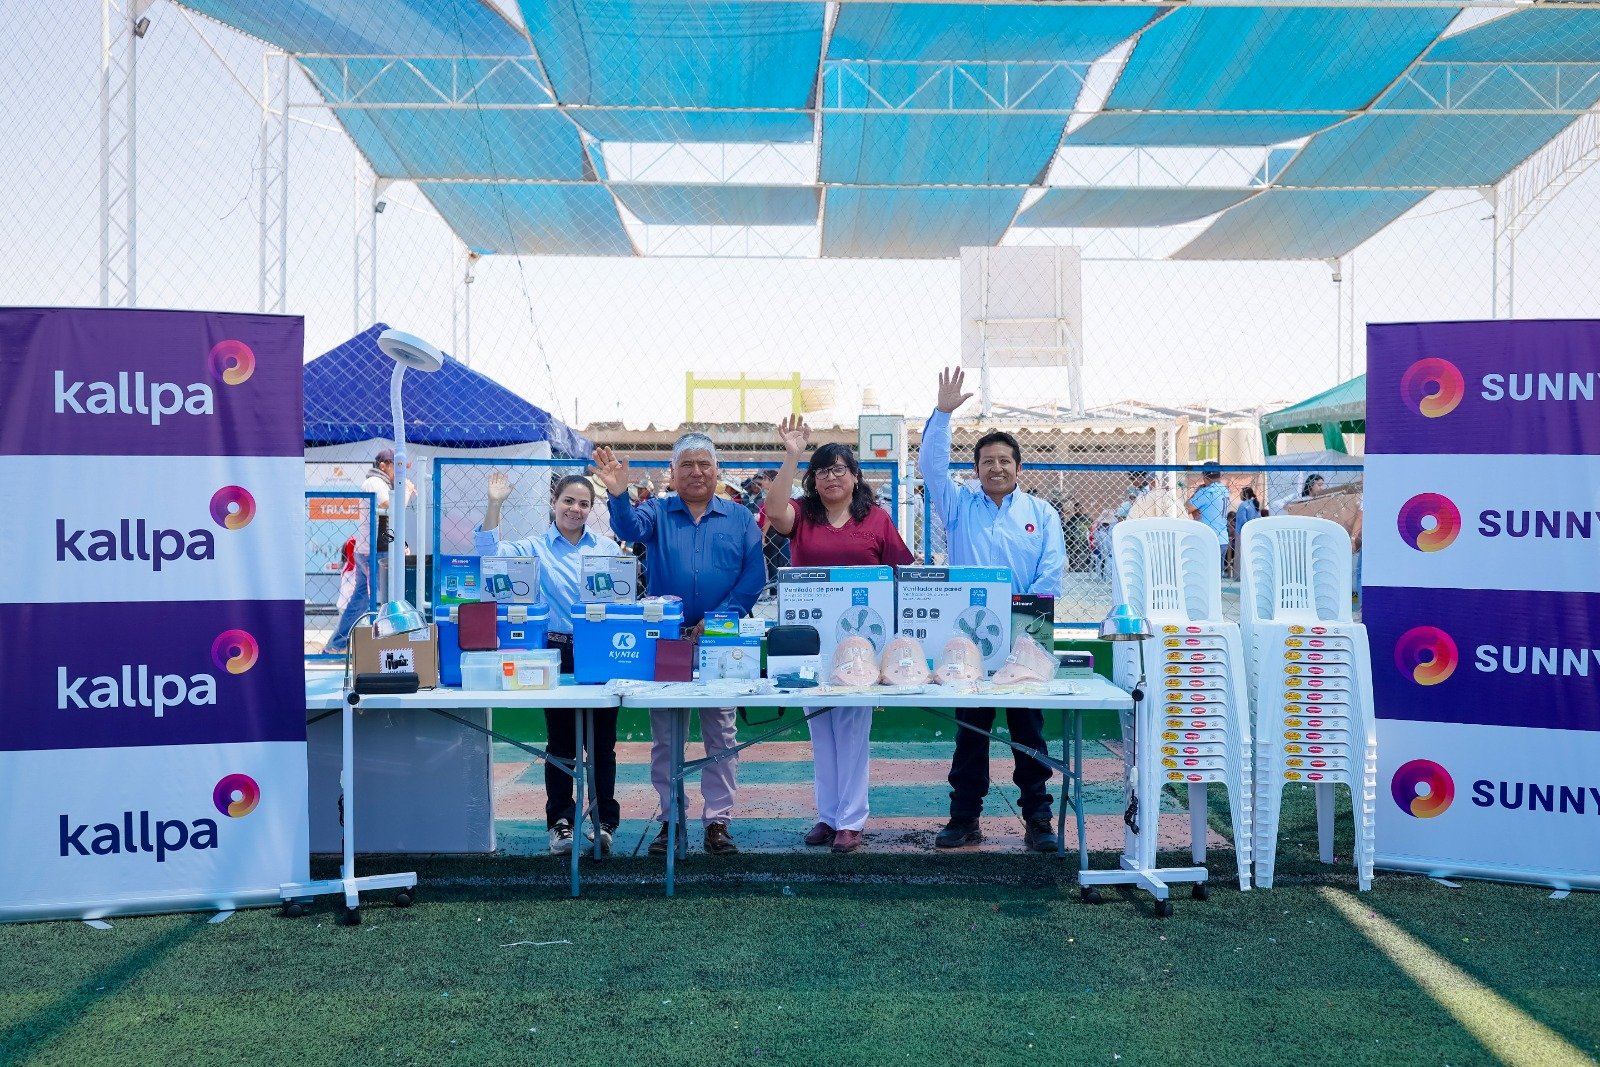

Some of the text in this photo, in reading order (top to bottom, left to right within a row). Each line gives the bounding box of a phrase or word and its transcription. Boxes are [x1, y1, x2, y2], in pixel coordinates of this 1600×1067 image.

[54, 370, 214, 425] kallpa
[1481, 372, 1600, 401] SUNN
[56, 518, 215, 571] kallpa
[1478, 509, 1600, 539] SUNN
[57, 664, 217, 718] kallpa
[59, 810, 219, 863] kallpa
